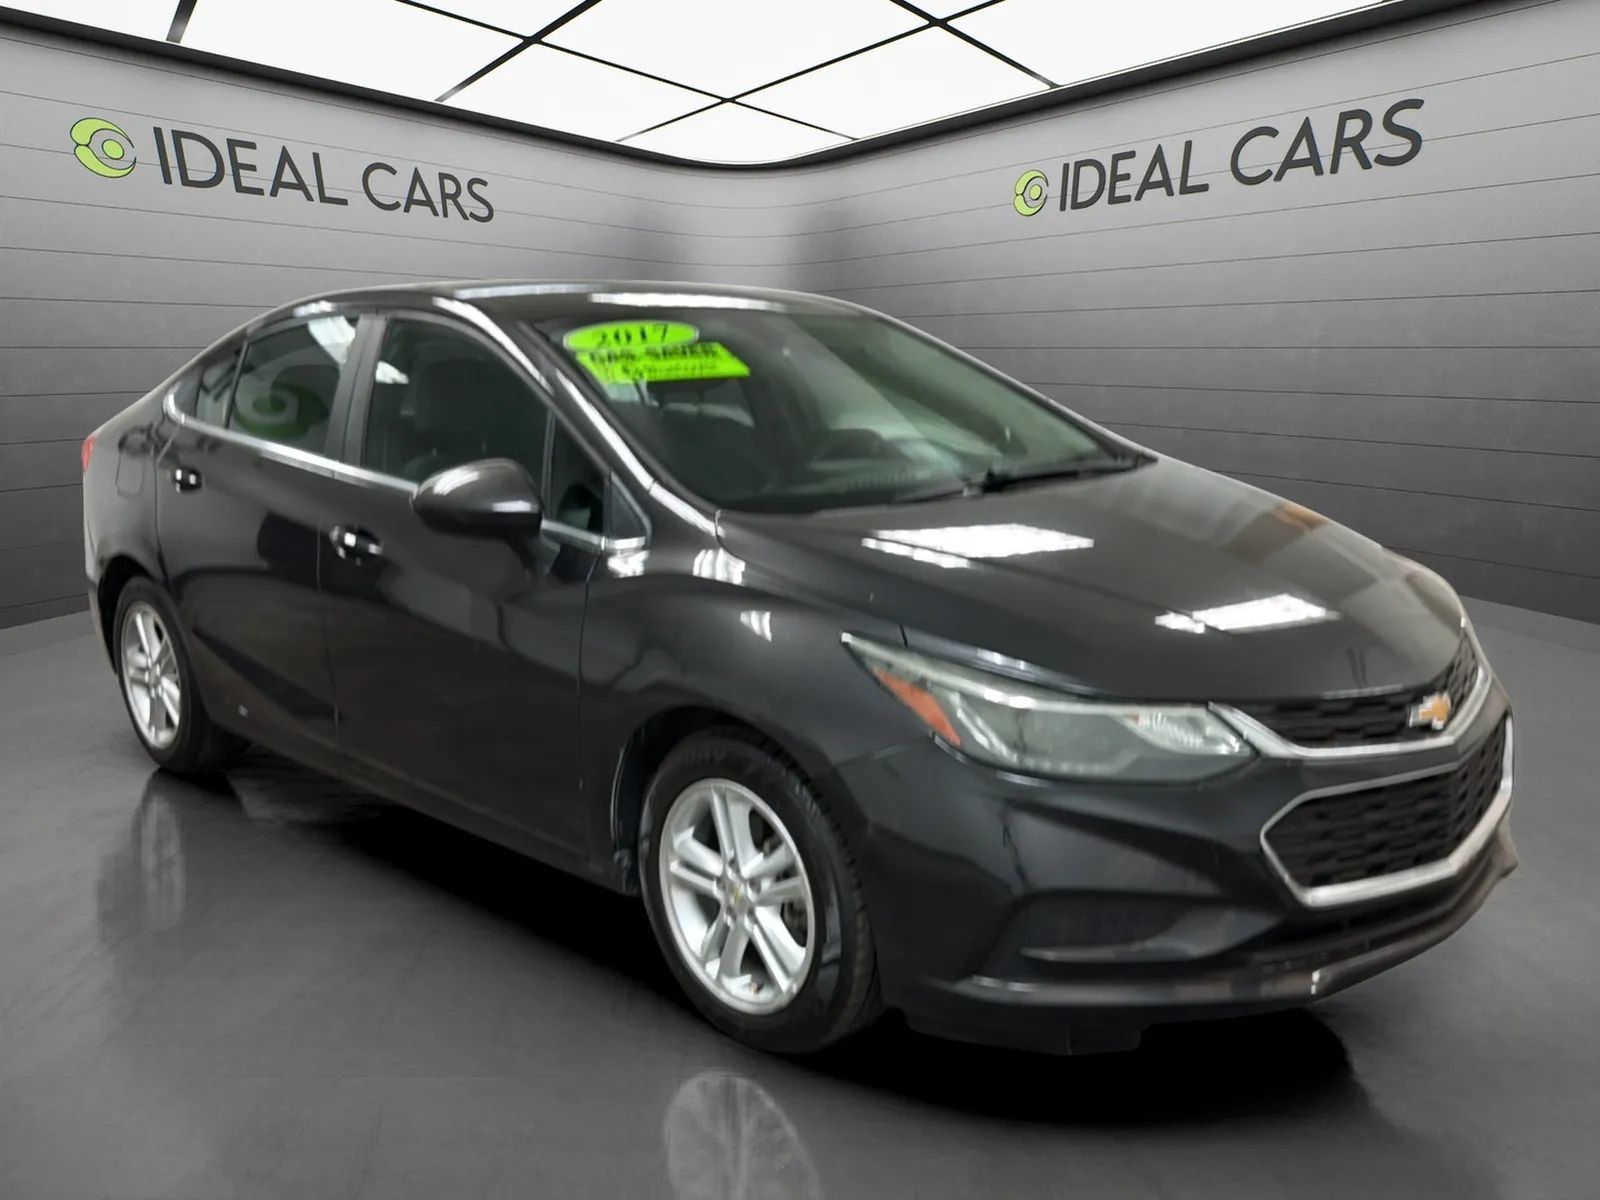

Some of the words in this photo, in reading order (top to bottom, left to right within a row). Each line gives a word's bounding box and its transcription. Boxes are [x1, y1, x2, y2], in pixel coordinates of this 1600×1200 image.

[153, 126, 348, 206] IDEAL
[361, 162, 494, 223] CARS
[1059, 140, 1210, 212] IDEAL
[1230, 98, 1425, 186] CARS
[592, 323, 669, 347] 2017
